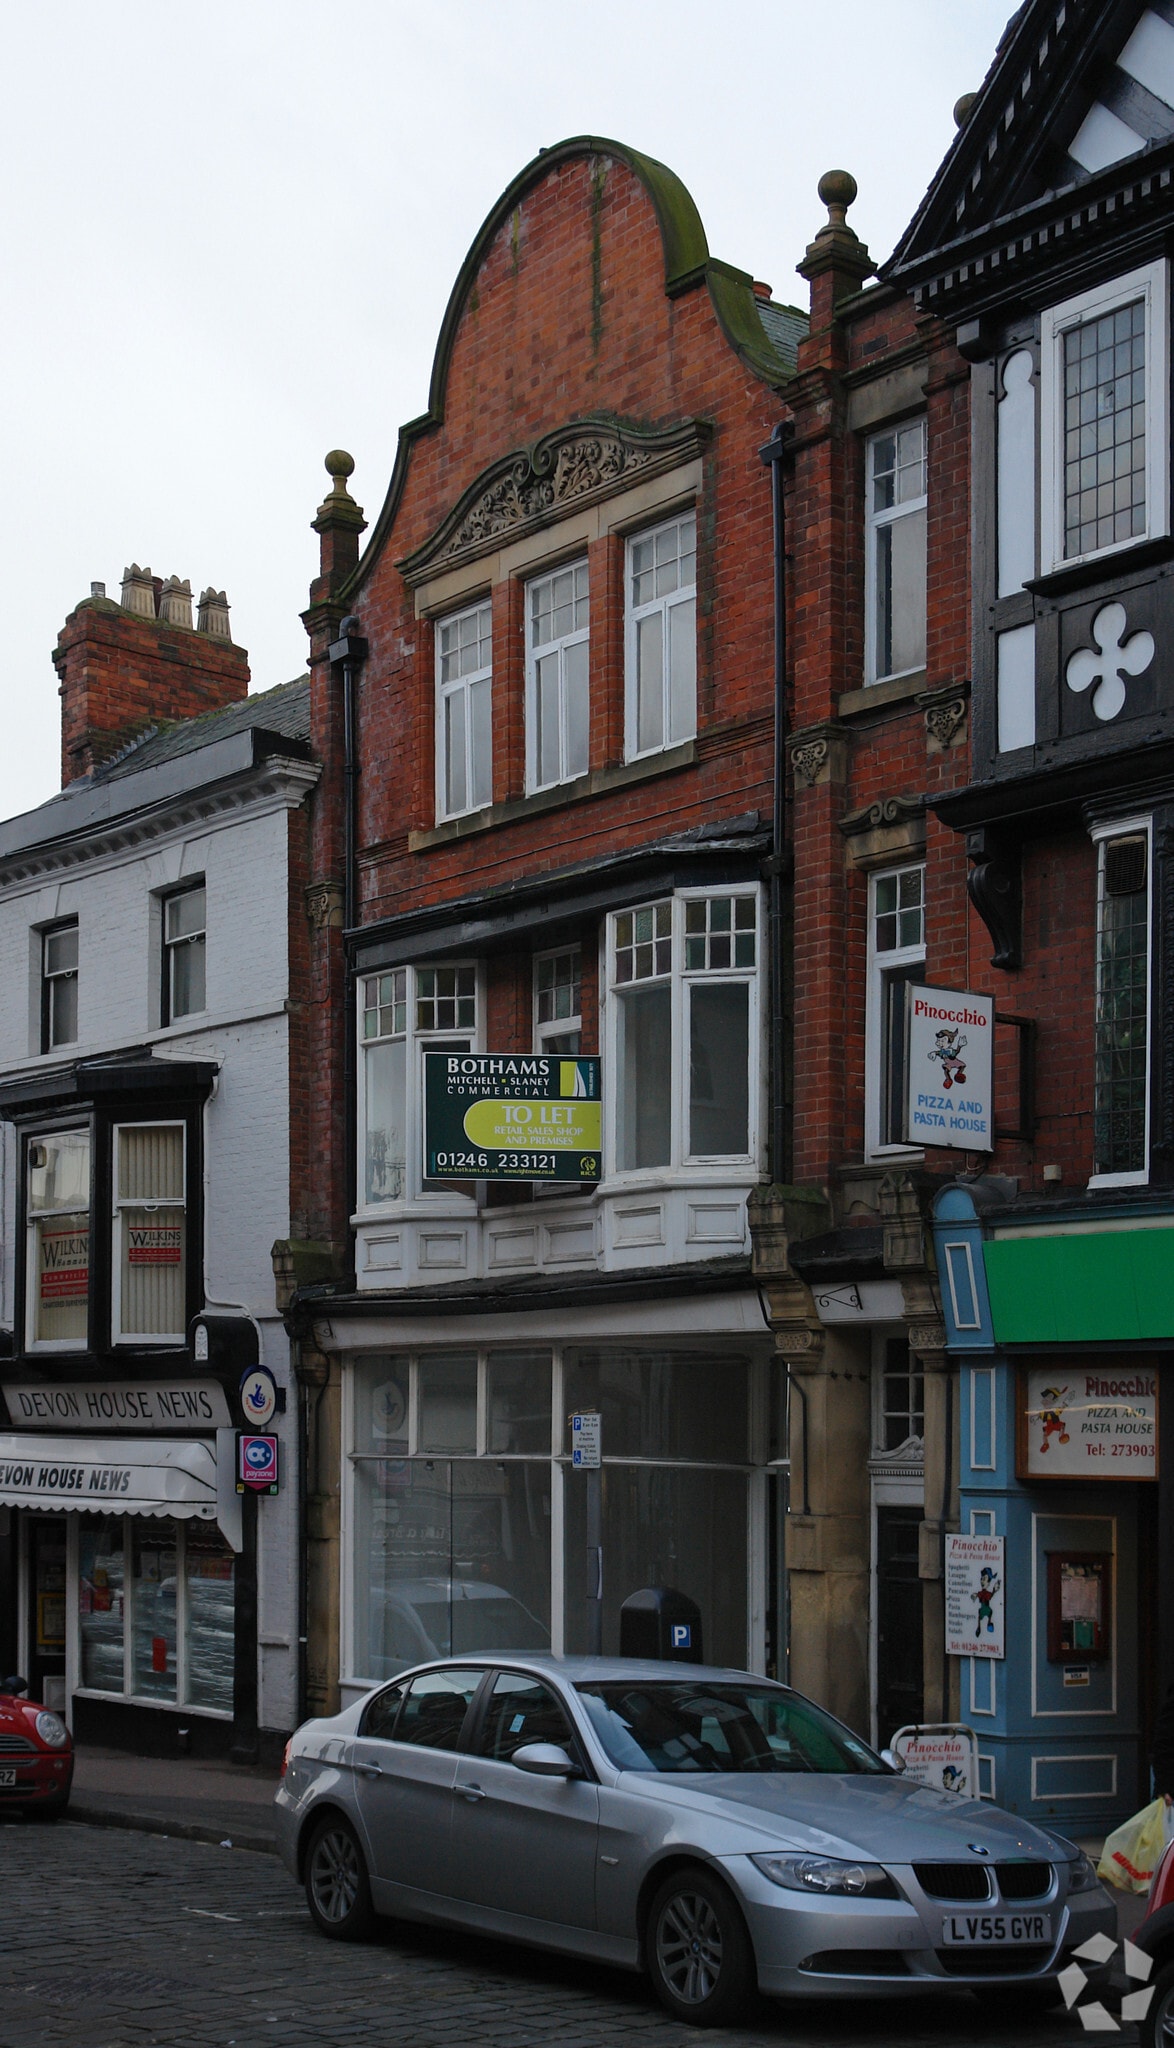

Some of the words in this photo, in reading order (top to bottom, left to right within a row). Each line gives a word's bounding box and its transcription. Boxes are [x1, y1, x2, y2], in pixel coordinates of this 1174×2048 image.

[914, 1000, 987, 1027] Pinocchio
[447, 1057, 550, 1076] BOTHAMS
[447, 1076, 498, 1085] MITCHELL
[510, 1077, 550, 1086] SLANEY
[447, 1086, 550, 1097] COMMERCIAL
[917, 1094, 954, 1111] PIZZA
[957, 1100, 983, 1115] AND
[501, 1105, 532, 1124] TO
[540, 1106, 577, 1125] LET
[913, 1111, 946, 1128] PASTA
[950, 1117, 987, 1133] HOUSE
[494, 1126, 523, 1135] RETAIL
[527, 1126, 553, 1136] SALES
[556, 1127, 584, 1136] SHOP
[505, 1136, 527, 1145] AND
[530, 1136, 574, 1146] PREMISES
[437, 1152, 488, 1167] 01246
[498, 1153, 557, 1169] 233121
[129, 1231, 181, 1247] WILKINS
[42, 1237, 88, 1268] WILKIN
[57, 1258, 87, 1267] Hammon
[18, 1391, 81, 1418] DEVON
[85, 1391, 153, 1419] HOUSE
[156, 1390, 214, 1419] NEWS
[1087, 1407, 1118, 1418] PIZZA
[1121, 1407, 1146, 1418] AND
[574, 1418, 581, 1430] P
[1080, 1423, 1111, 1434] PASTA
[1115, 1423, 1153, 1434] HOUSE
[1086, 1443, 1106, 1456] Tel:
[1111, 1444, 1155, 1457] 273903
[37, 1467, 85, 1490] HOUSE
[89, 1469, 131, 1492] NEWS
[246, 1470, 274, 1479] payzone
[951, 1539, 998, 1552] Pinocchio
[674, 1626, 687, 1646] P
[950, 1641, 961, 1650] Tel:
[907, 1740, 962, 1753] Pinocchio
[906, 1764, 929, 1772] paghetti
[951, 1917, 1007, 1941] LV55
[1011, 1916, 1044, 1939] GYR
